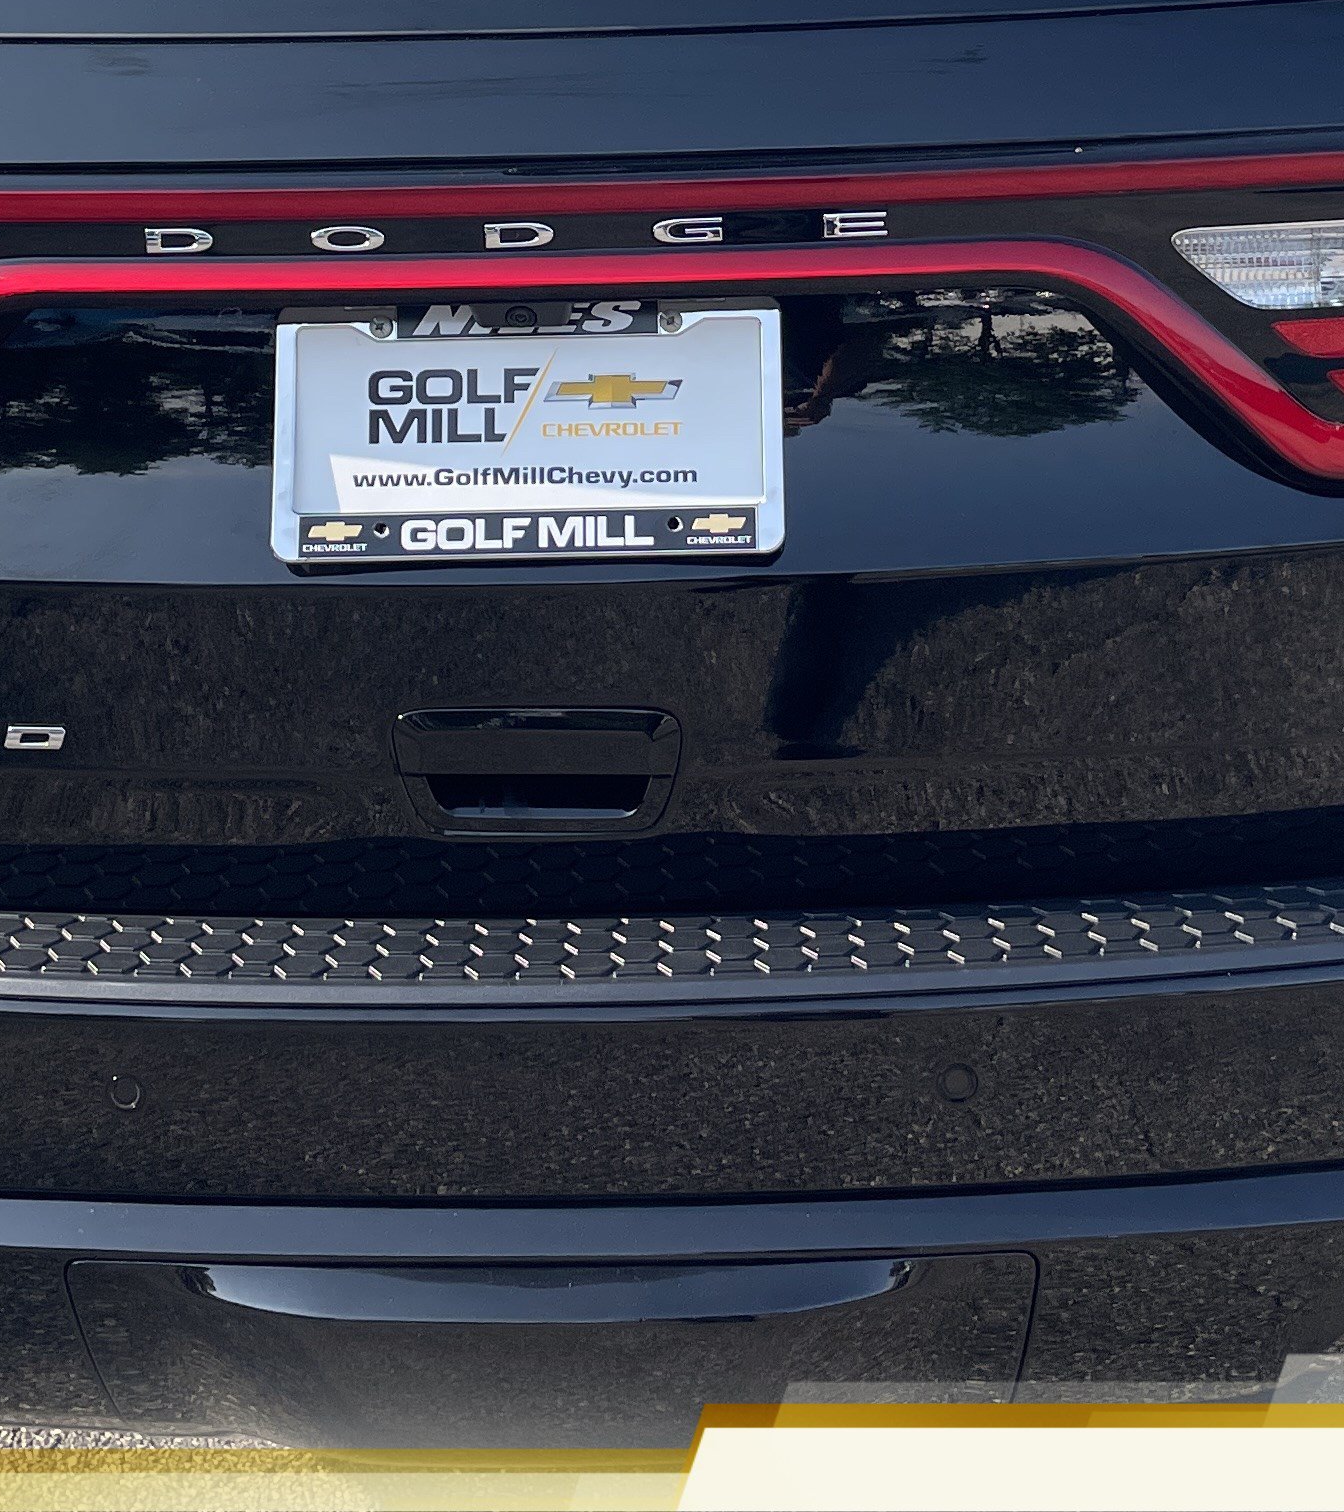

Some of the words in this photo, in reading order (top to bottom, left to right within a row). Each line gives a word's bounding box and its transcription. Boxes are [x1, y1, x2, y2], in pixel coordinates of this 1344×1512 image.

[144, 210, 890, 255] DODGE
[367, 366, 540, 406] GOLF
[368, 406, 507, 445] MILL
[542, 420, 683, 438] CHEVROLET
[353, 464, 699, 491] www.GolfMillChevy.com
[302, 543, 368, 553] CHEVROLET
[400, 517, 534, 551] GOLF
[538, 515, 654, 549] MILL
[686, 534, 752, 545] CHEVROLET
